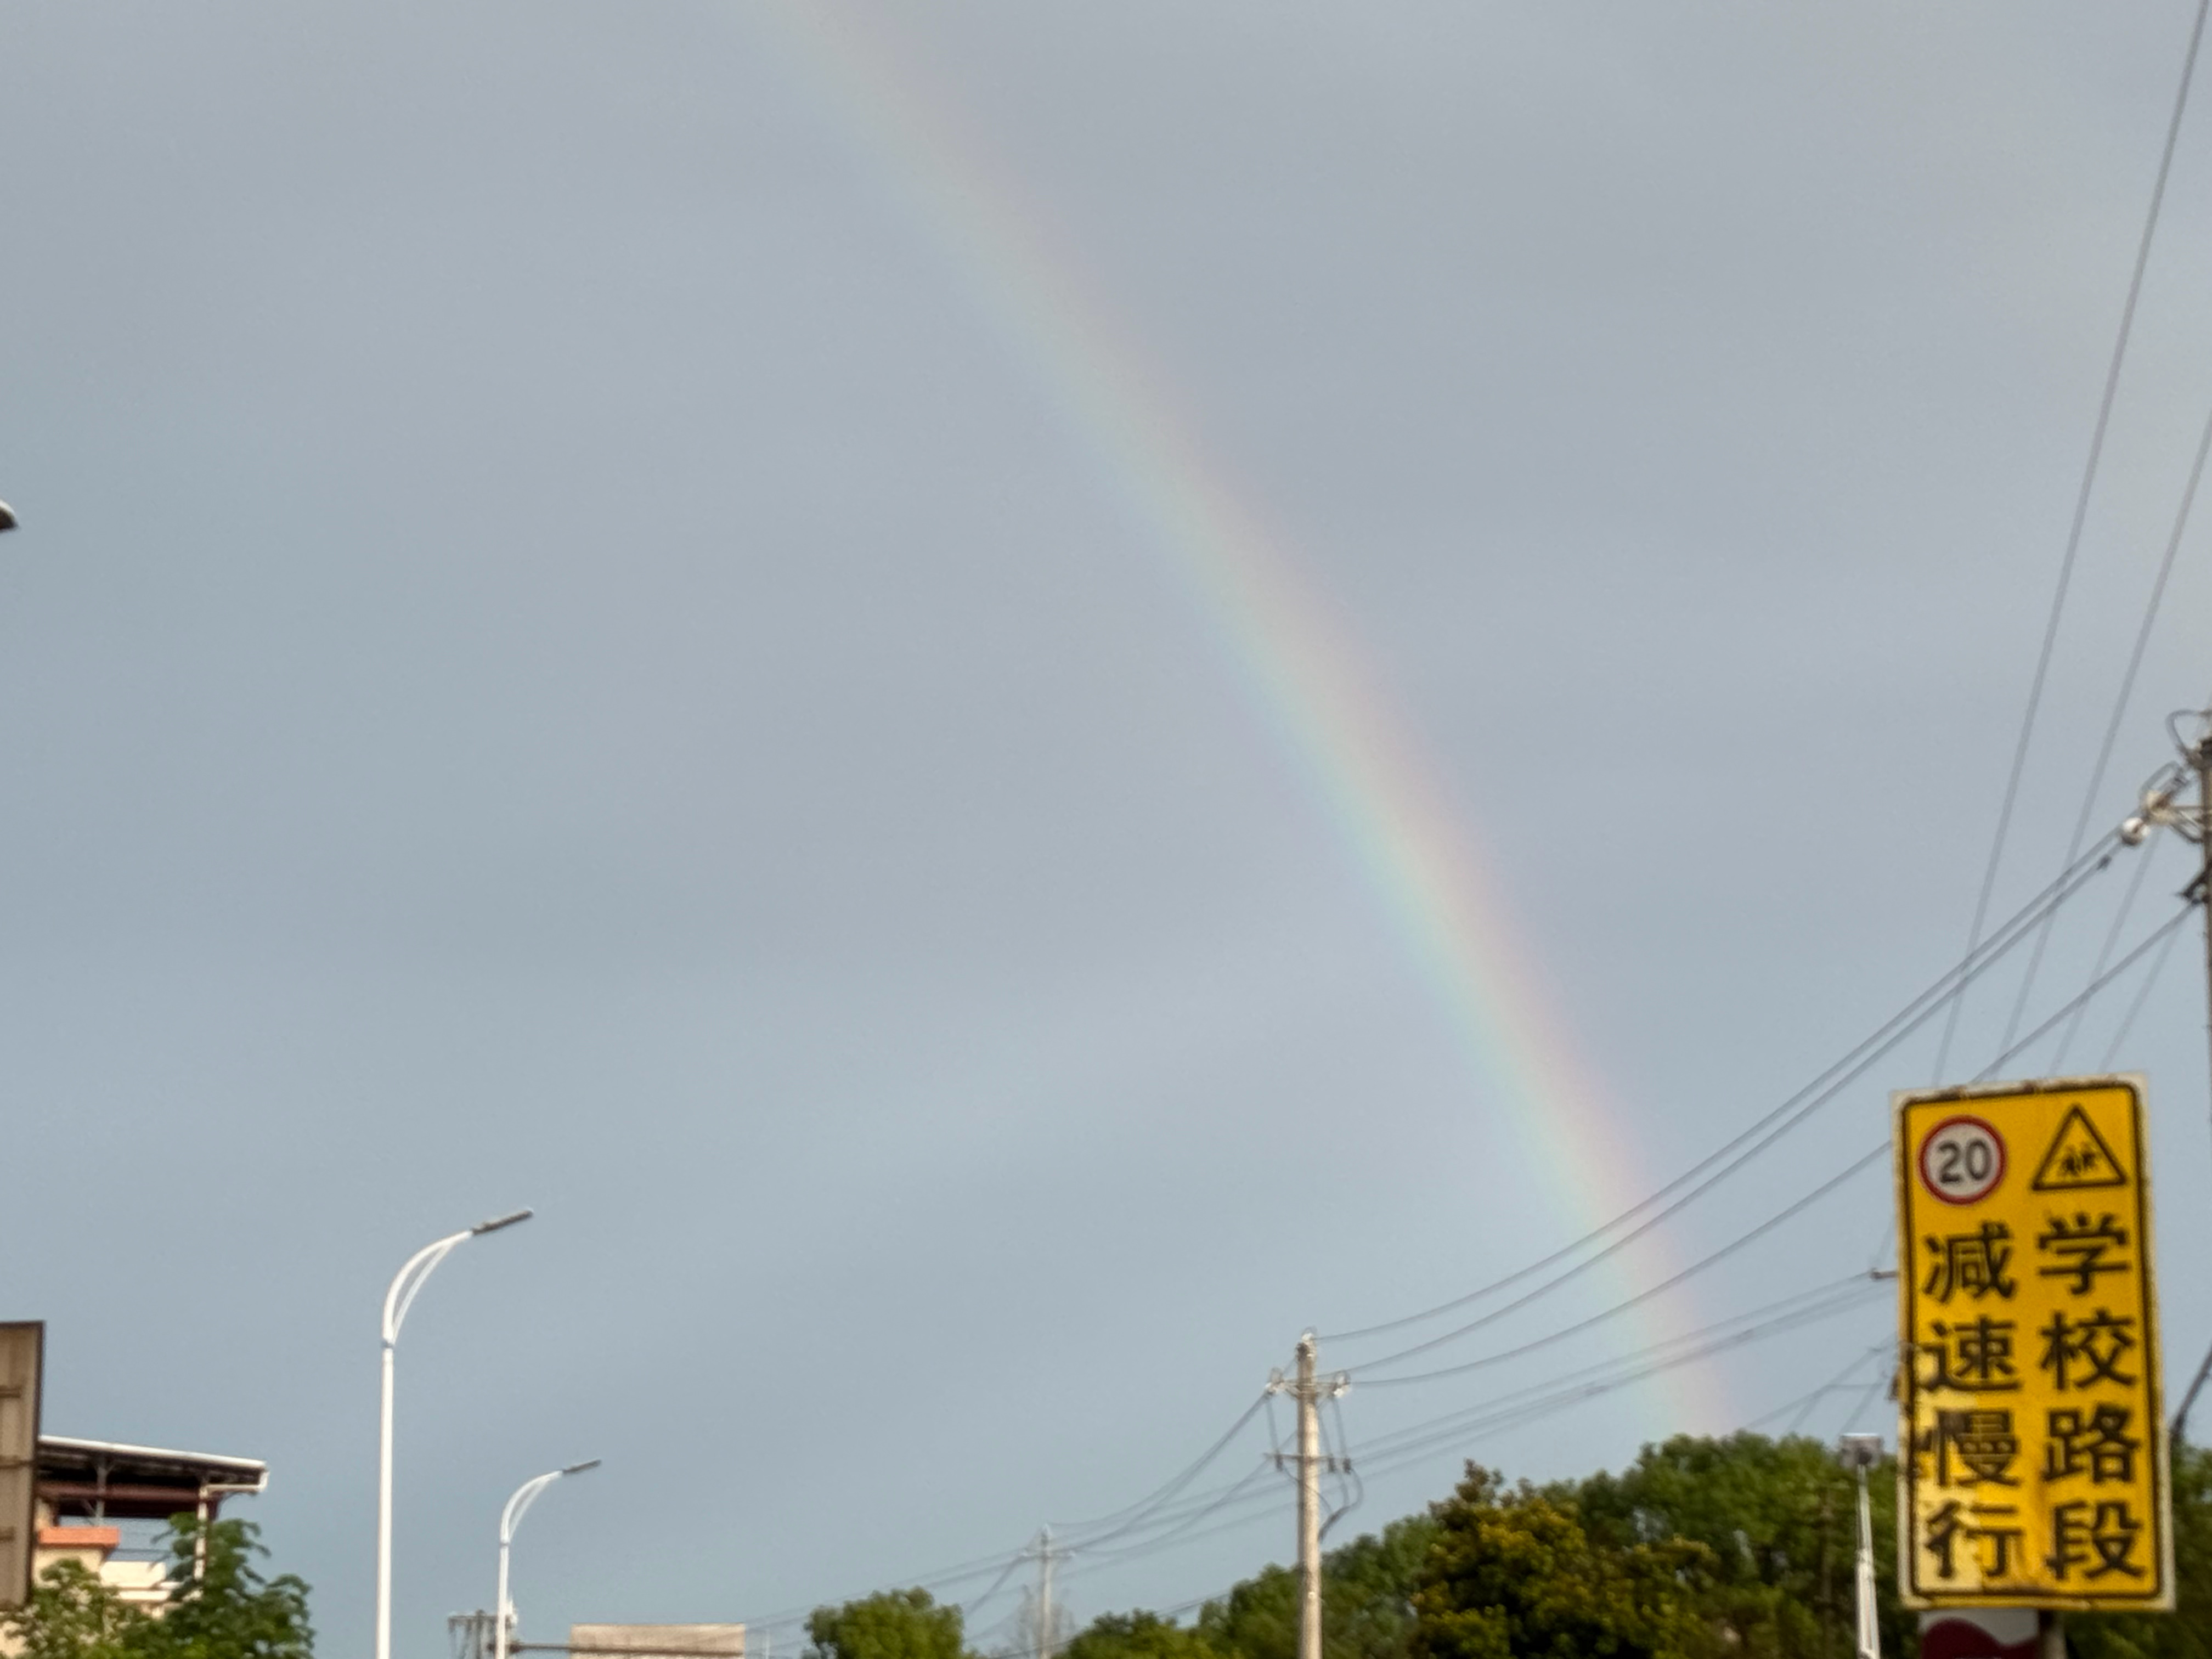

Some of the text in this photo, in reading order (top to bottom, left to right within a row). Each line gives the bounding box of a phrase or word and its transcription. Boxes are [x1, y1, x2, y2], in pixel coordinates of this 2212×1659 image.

[1937, 1139, 1991, 1183] 20
[1918, 1221, 2023, 1578] 减速慢行
[2038, 1212, 2146, 1580] 学校路段
